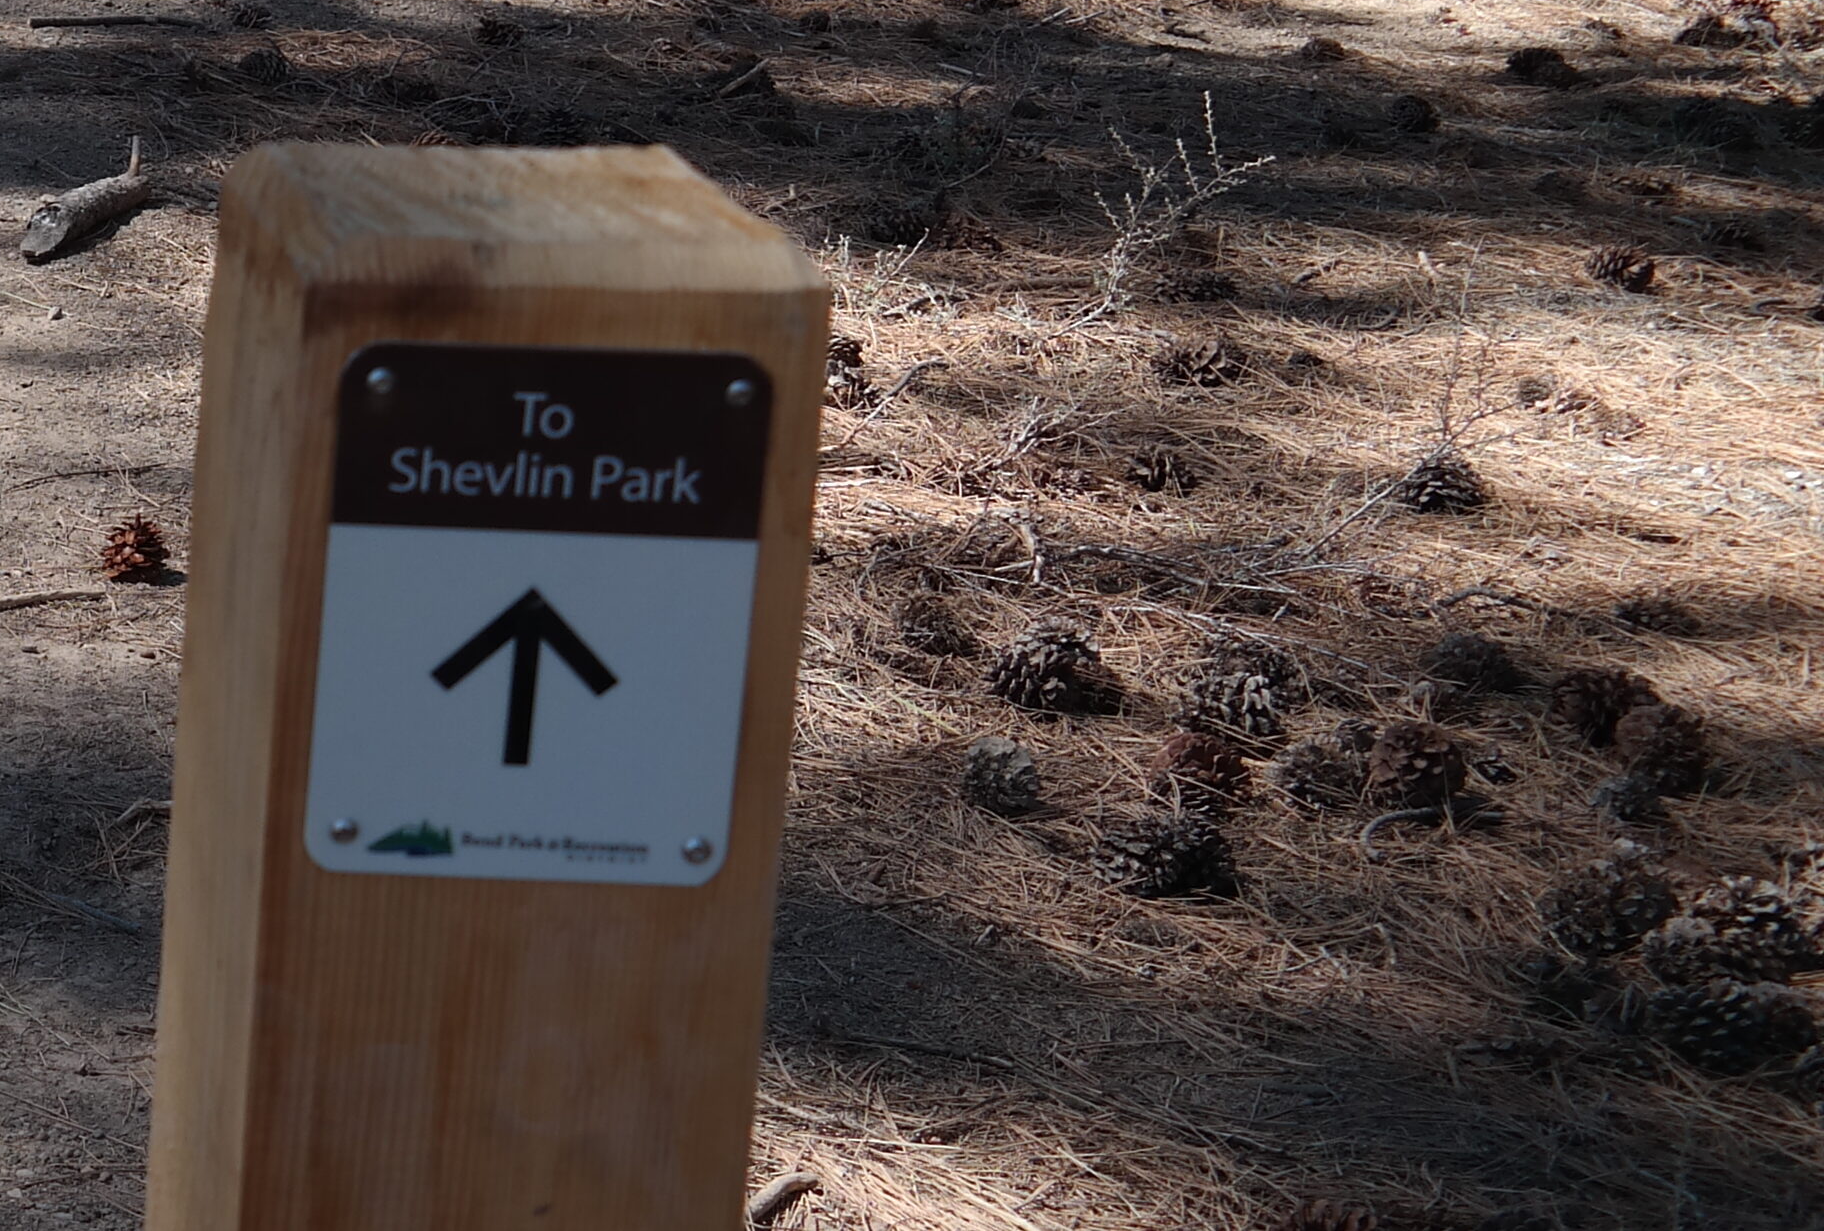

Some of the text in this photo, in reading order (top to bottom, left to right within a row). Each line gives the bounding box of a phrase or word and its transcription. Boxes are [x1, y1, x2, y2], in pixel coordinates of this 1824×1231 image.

[513, 391, 575, 439] To
[388, 447, 702, 504] Shevlin Park
